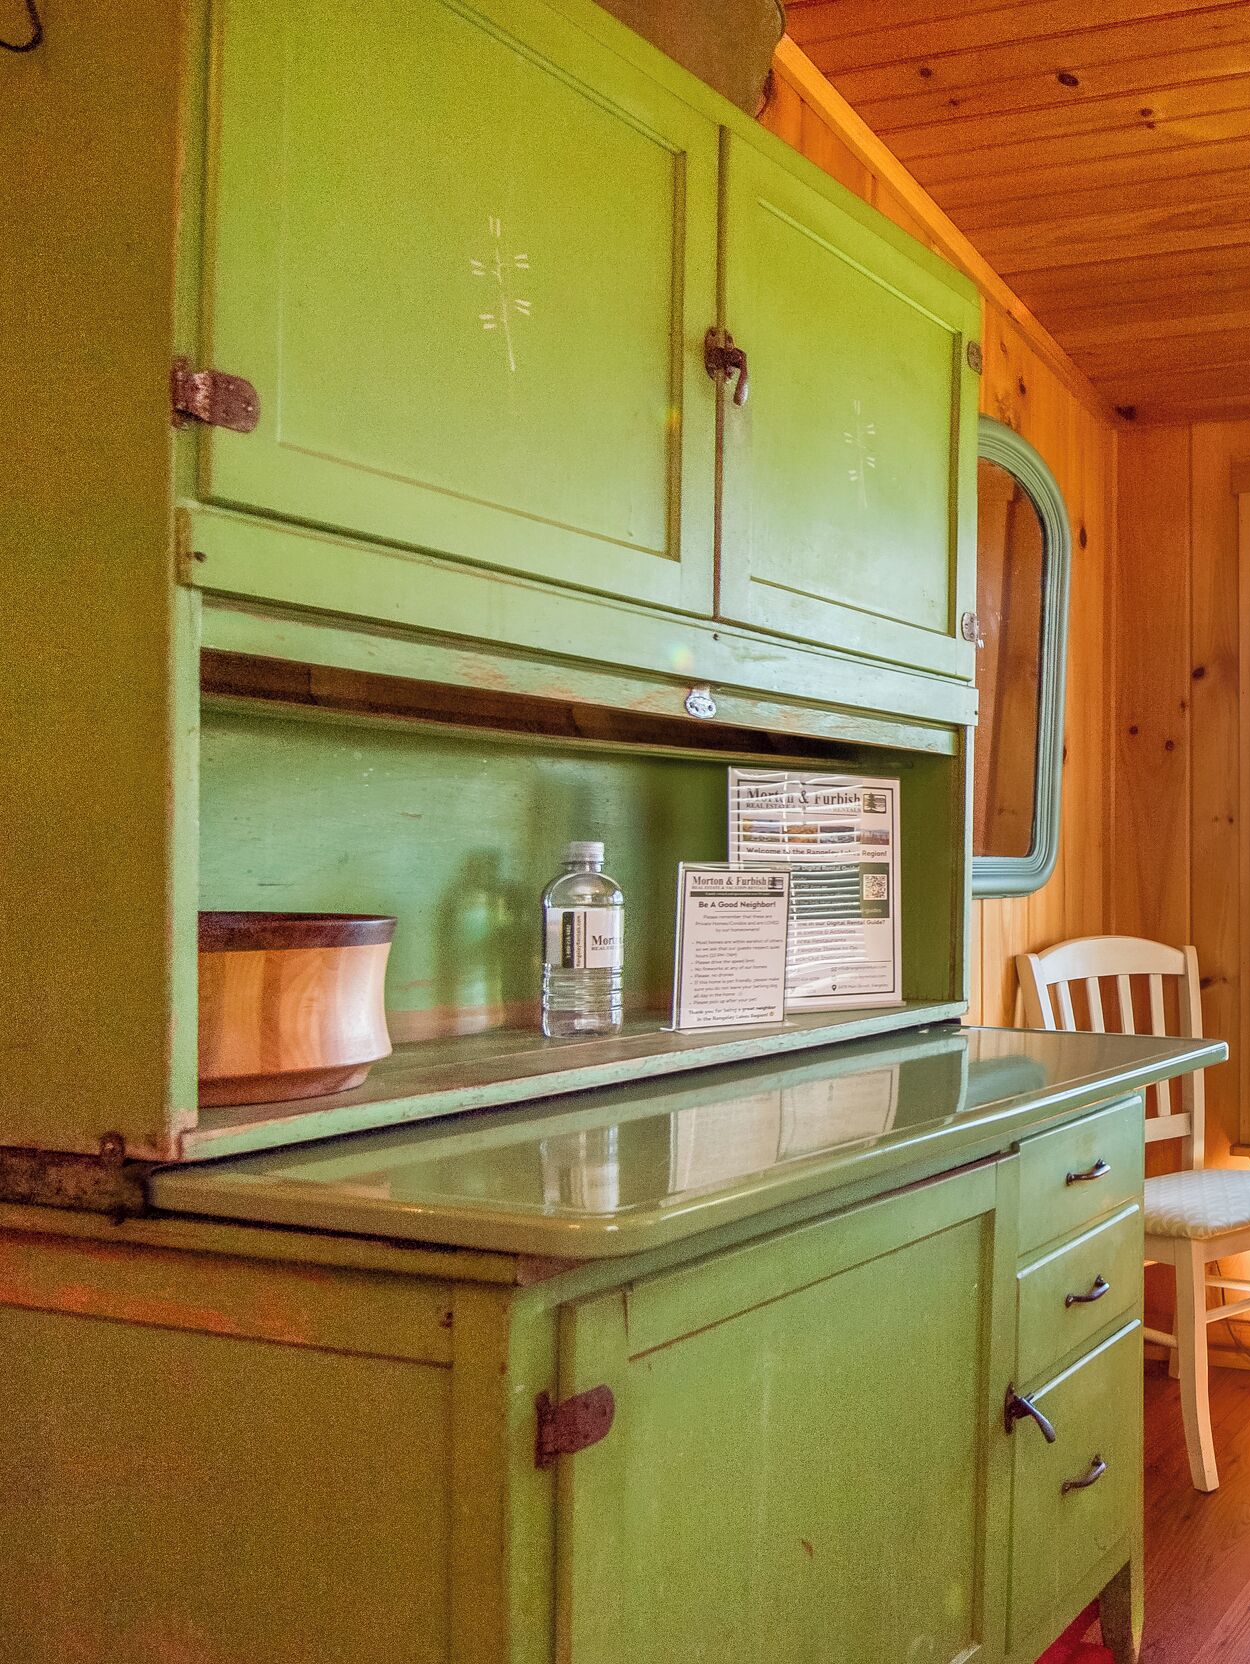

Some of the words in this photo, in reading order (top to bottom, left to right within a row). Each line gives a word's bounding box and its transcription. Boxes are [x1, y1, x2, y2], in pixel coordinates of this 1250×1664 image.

[799, 790, 809, 804] &
[692, 876, 724, 885] Morton
[726, 876, 733, 885] &
[736, 876, 766, 885] Furbish
[740, 900, 776, 910] Neighbor!
